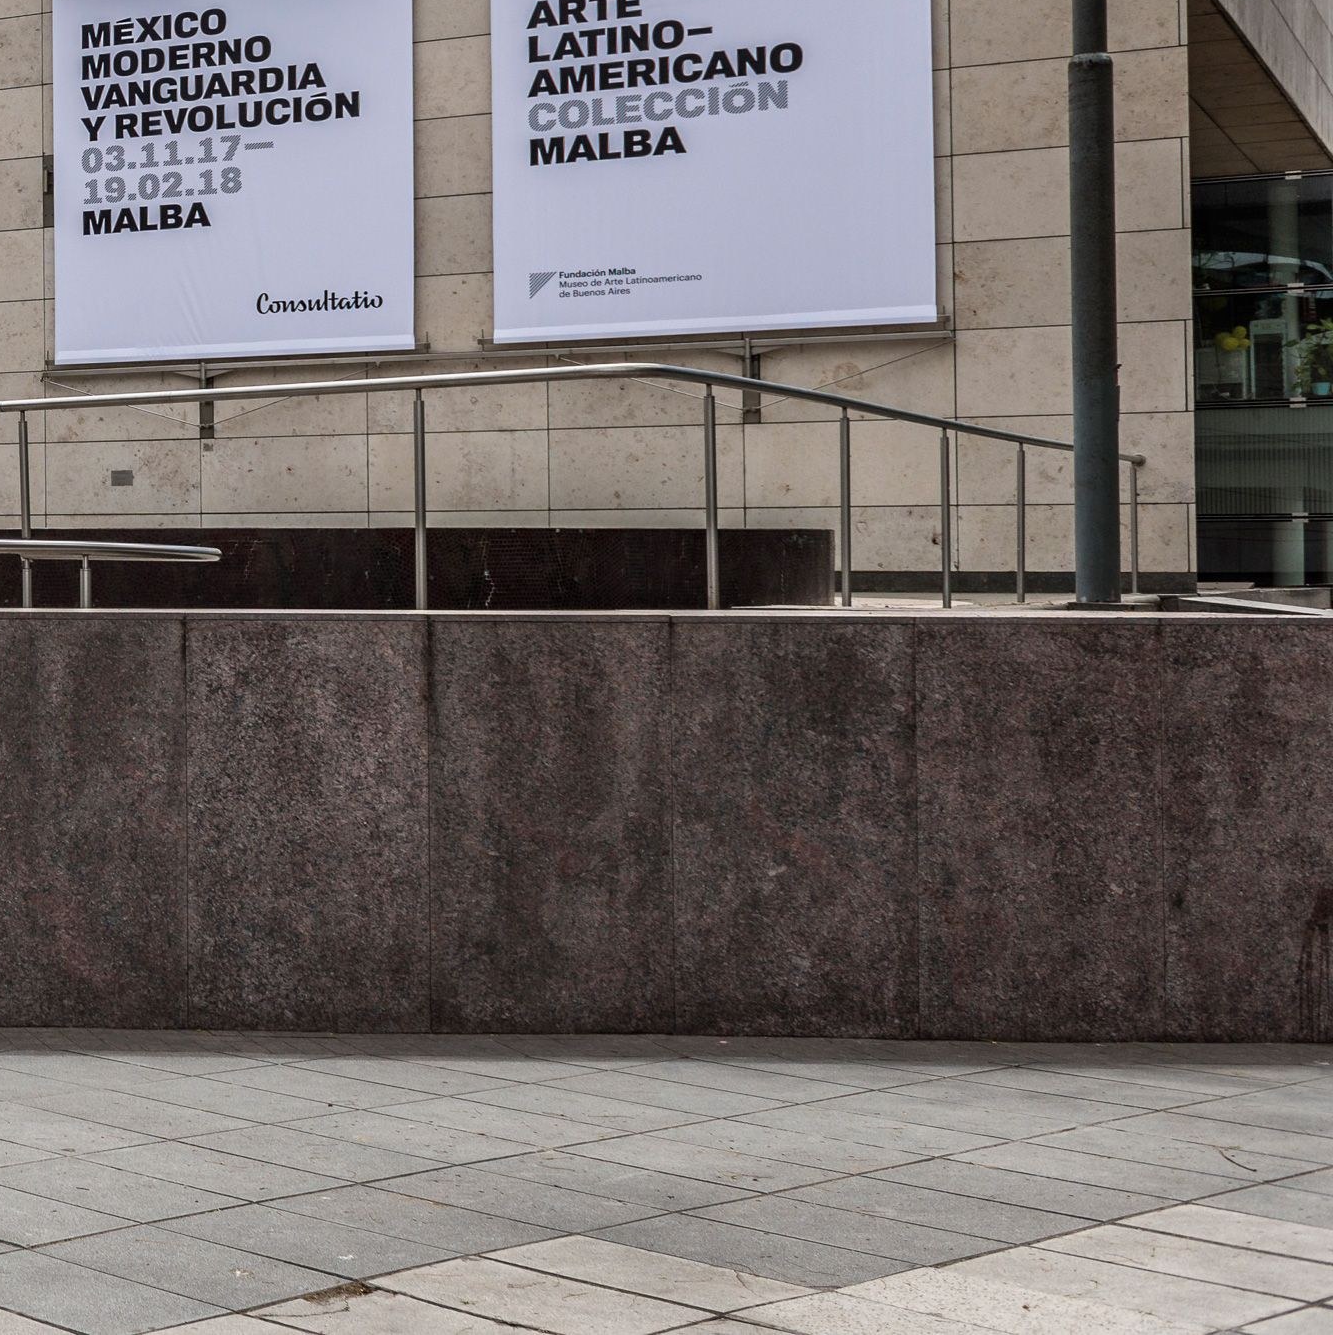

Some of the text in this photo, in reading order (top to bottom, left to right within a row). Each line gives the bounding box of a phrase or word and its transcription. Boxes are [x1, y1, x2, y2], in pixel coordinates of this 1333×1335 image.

[82, 9, 226, 50] MÉXICO
[82, 36, 271, 81] MODERNO
[528, 43, 803, 98] AMERICANO
[81, 63, 326, 111] VANGUARDIA
[528, 79, 788, 132] COLECCIÓN
[81, 91, 360, 142] Y REVOLUCIÓN
[530, 127, 687, 167] MALBA
[83, 166, 242, 205] 19.02.18
[83, 202, 211, 236] MALBA
[559, 267, 636, 279] Fundación Malba
[559, 273, 702, 288] Museo de Arte Latinoamericano
[559, 287, 631, 298] de Buenos Aires
[256, 289, 384, 315] Consultatio
